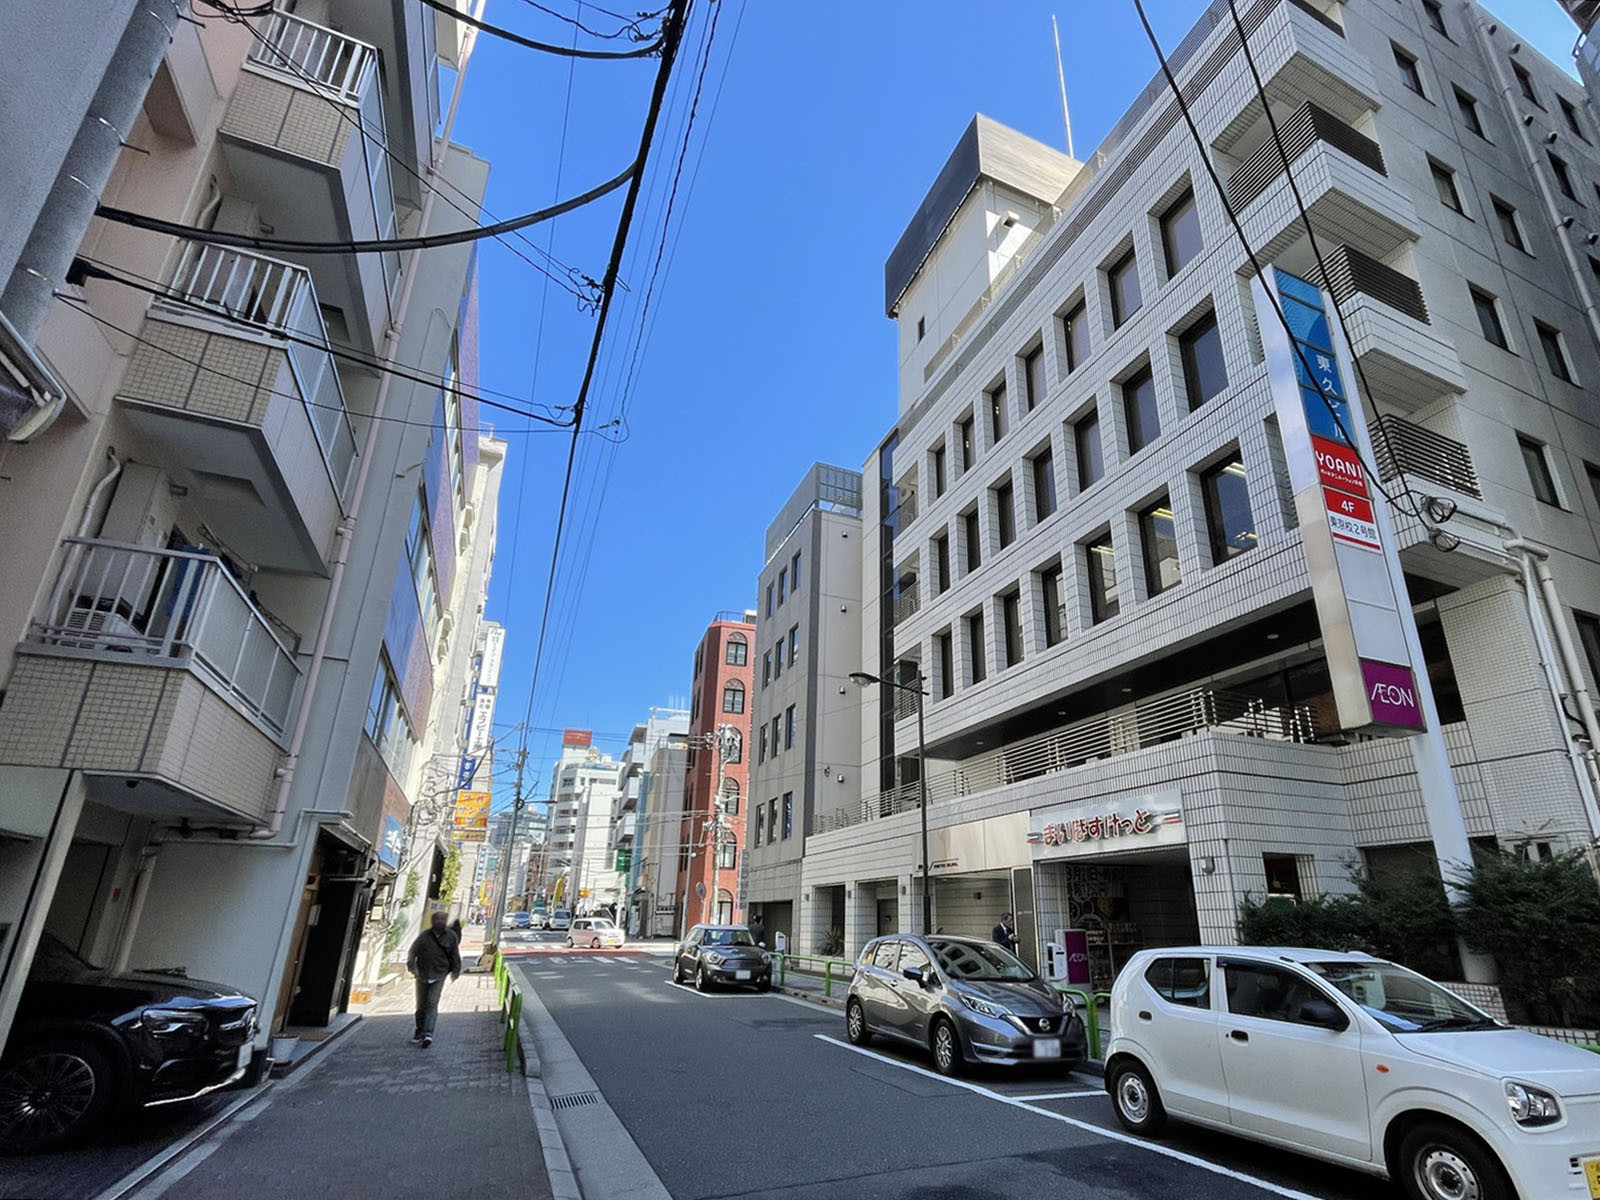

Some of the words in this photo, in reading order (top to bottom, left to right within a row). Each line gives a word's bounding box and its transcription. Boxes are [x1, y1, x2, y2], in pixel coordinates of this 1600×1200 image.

[1315, 450, 1362, 479] YOANI
[1341, 500, 1355, 513] 4F
[1042, 809, 1152, 847] まいばすけっと
